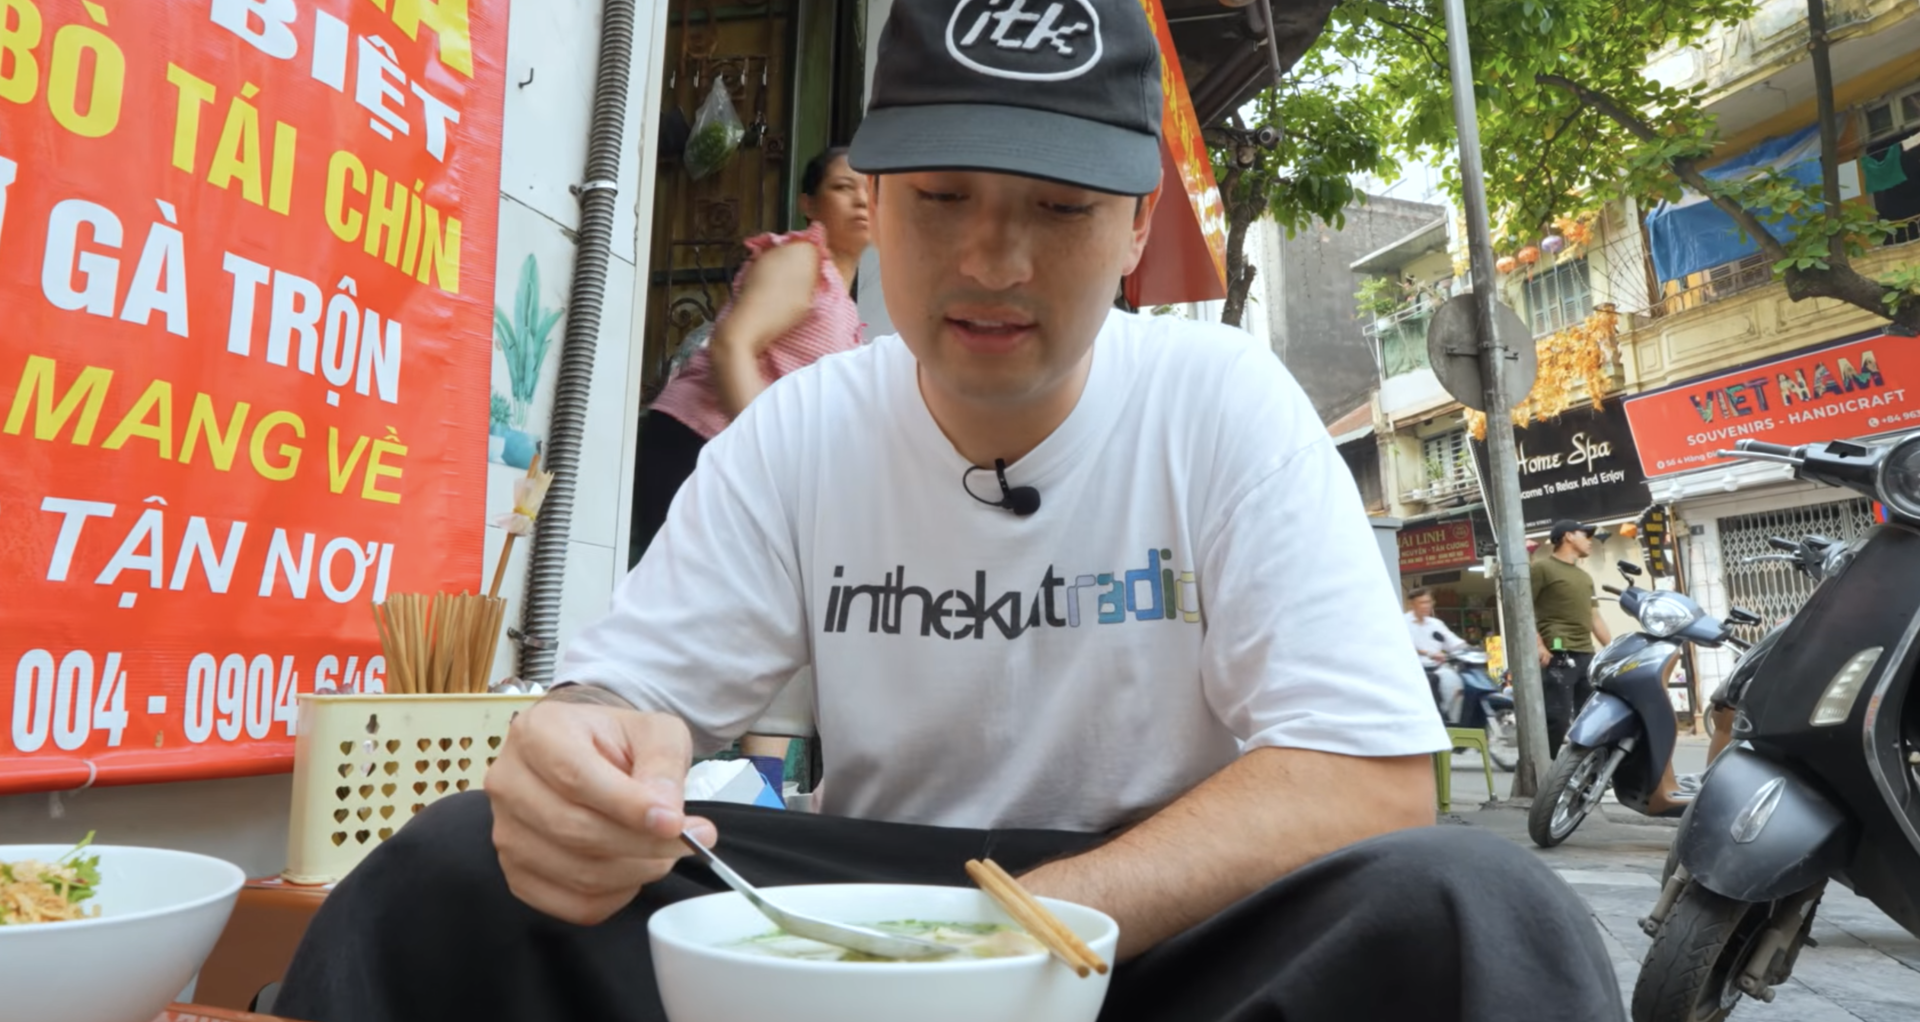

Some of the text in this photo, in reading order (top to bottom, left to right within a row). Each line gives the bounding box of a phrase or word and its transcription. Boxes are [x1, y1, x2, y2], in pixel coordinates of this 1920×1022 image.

[960, 0, 1088, 53] itk
[210, 0, 461, 163] BIỆT
[0, 0, 126, 138] BÒ
[166, 61, 297, 216] TÁI
[324, 149, 462, 295] CHÍN
[41, 198, 402, 407] GÀ TRỘN
[3, 354, 408, 504] MANG VỀ
[1686, 418, 1775, 446] SOUVENIRS
[1788, 389, 1906, 425] HANDICRAFT
[1689, 350, 1885, 423] VIET NAM
[1520, 469, 1625, 500] come To Relax And Enjoy
[1567, 432, 1613, 473] Spa
[40, 495, 395, 608] TẬN NƠI
[1416, 529, 1446, 546] LINH
[11, 648, 129, 753] 004
[184, 653, 298, 743] 0904
